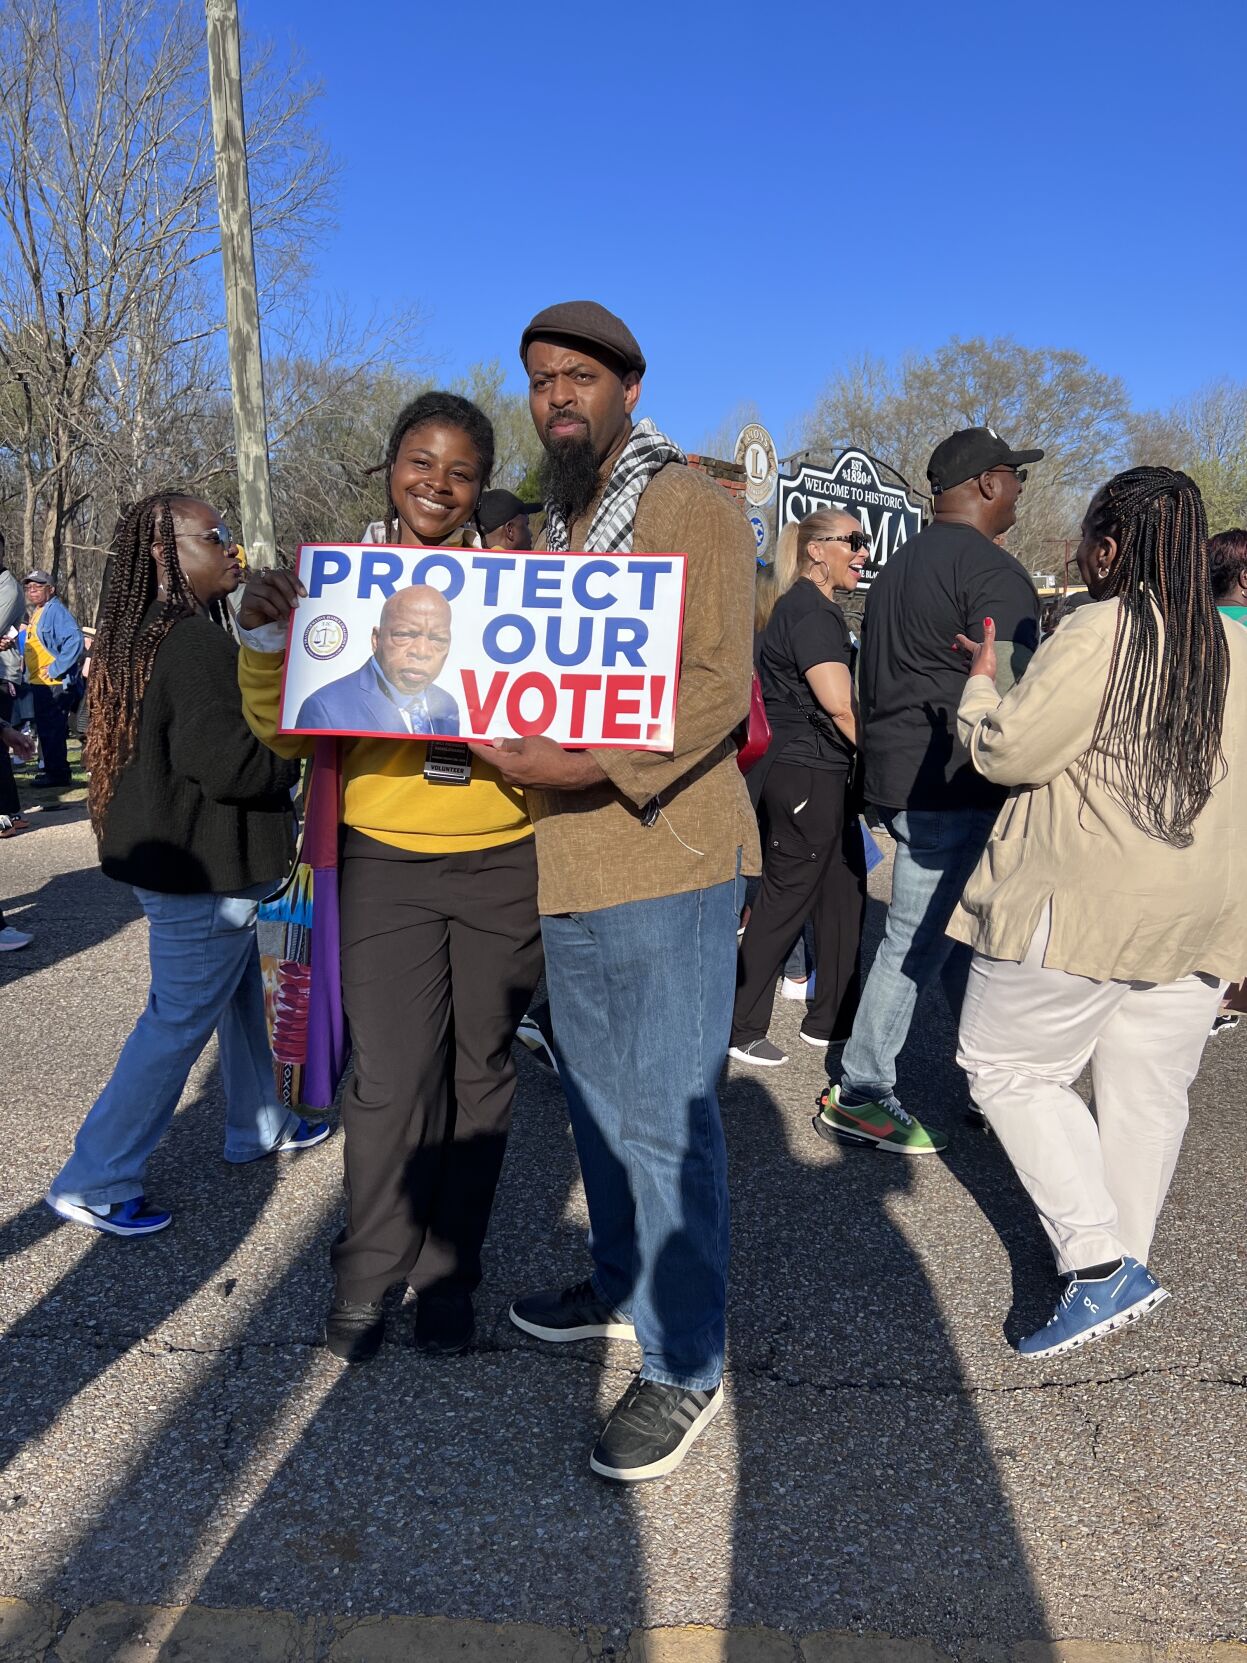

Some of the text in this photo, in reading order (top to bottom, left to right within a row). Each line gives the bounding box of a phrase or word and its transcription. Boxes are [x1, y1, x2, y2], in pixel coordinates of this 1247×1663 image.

[747, 430, 768, 447] LIONS
[751, 448, 763, 479] L
[847, 469, 866, 484] 1820
[851, 460, 863, 470] EST
[805, 477, 902, 509] WELCOME TO HISTORIC
[309, 550, 672, 610] PROTECT
[482, 613, 649, 668] OUR
[460, 669, 665, 741] VOTE!
[431, 765, 464, 774] VOLUNTEER
